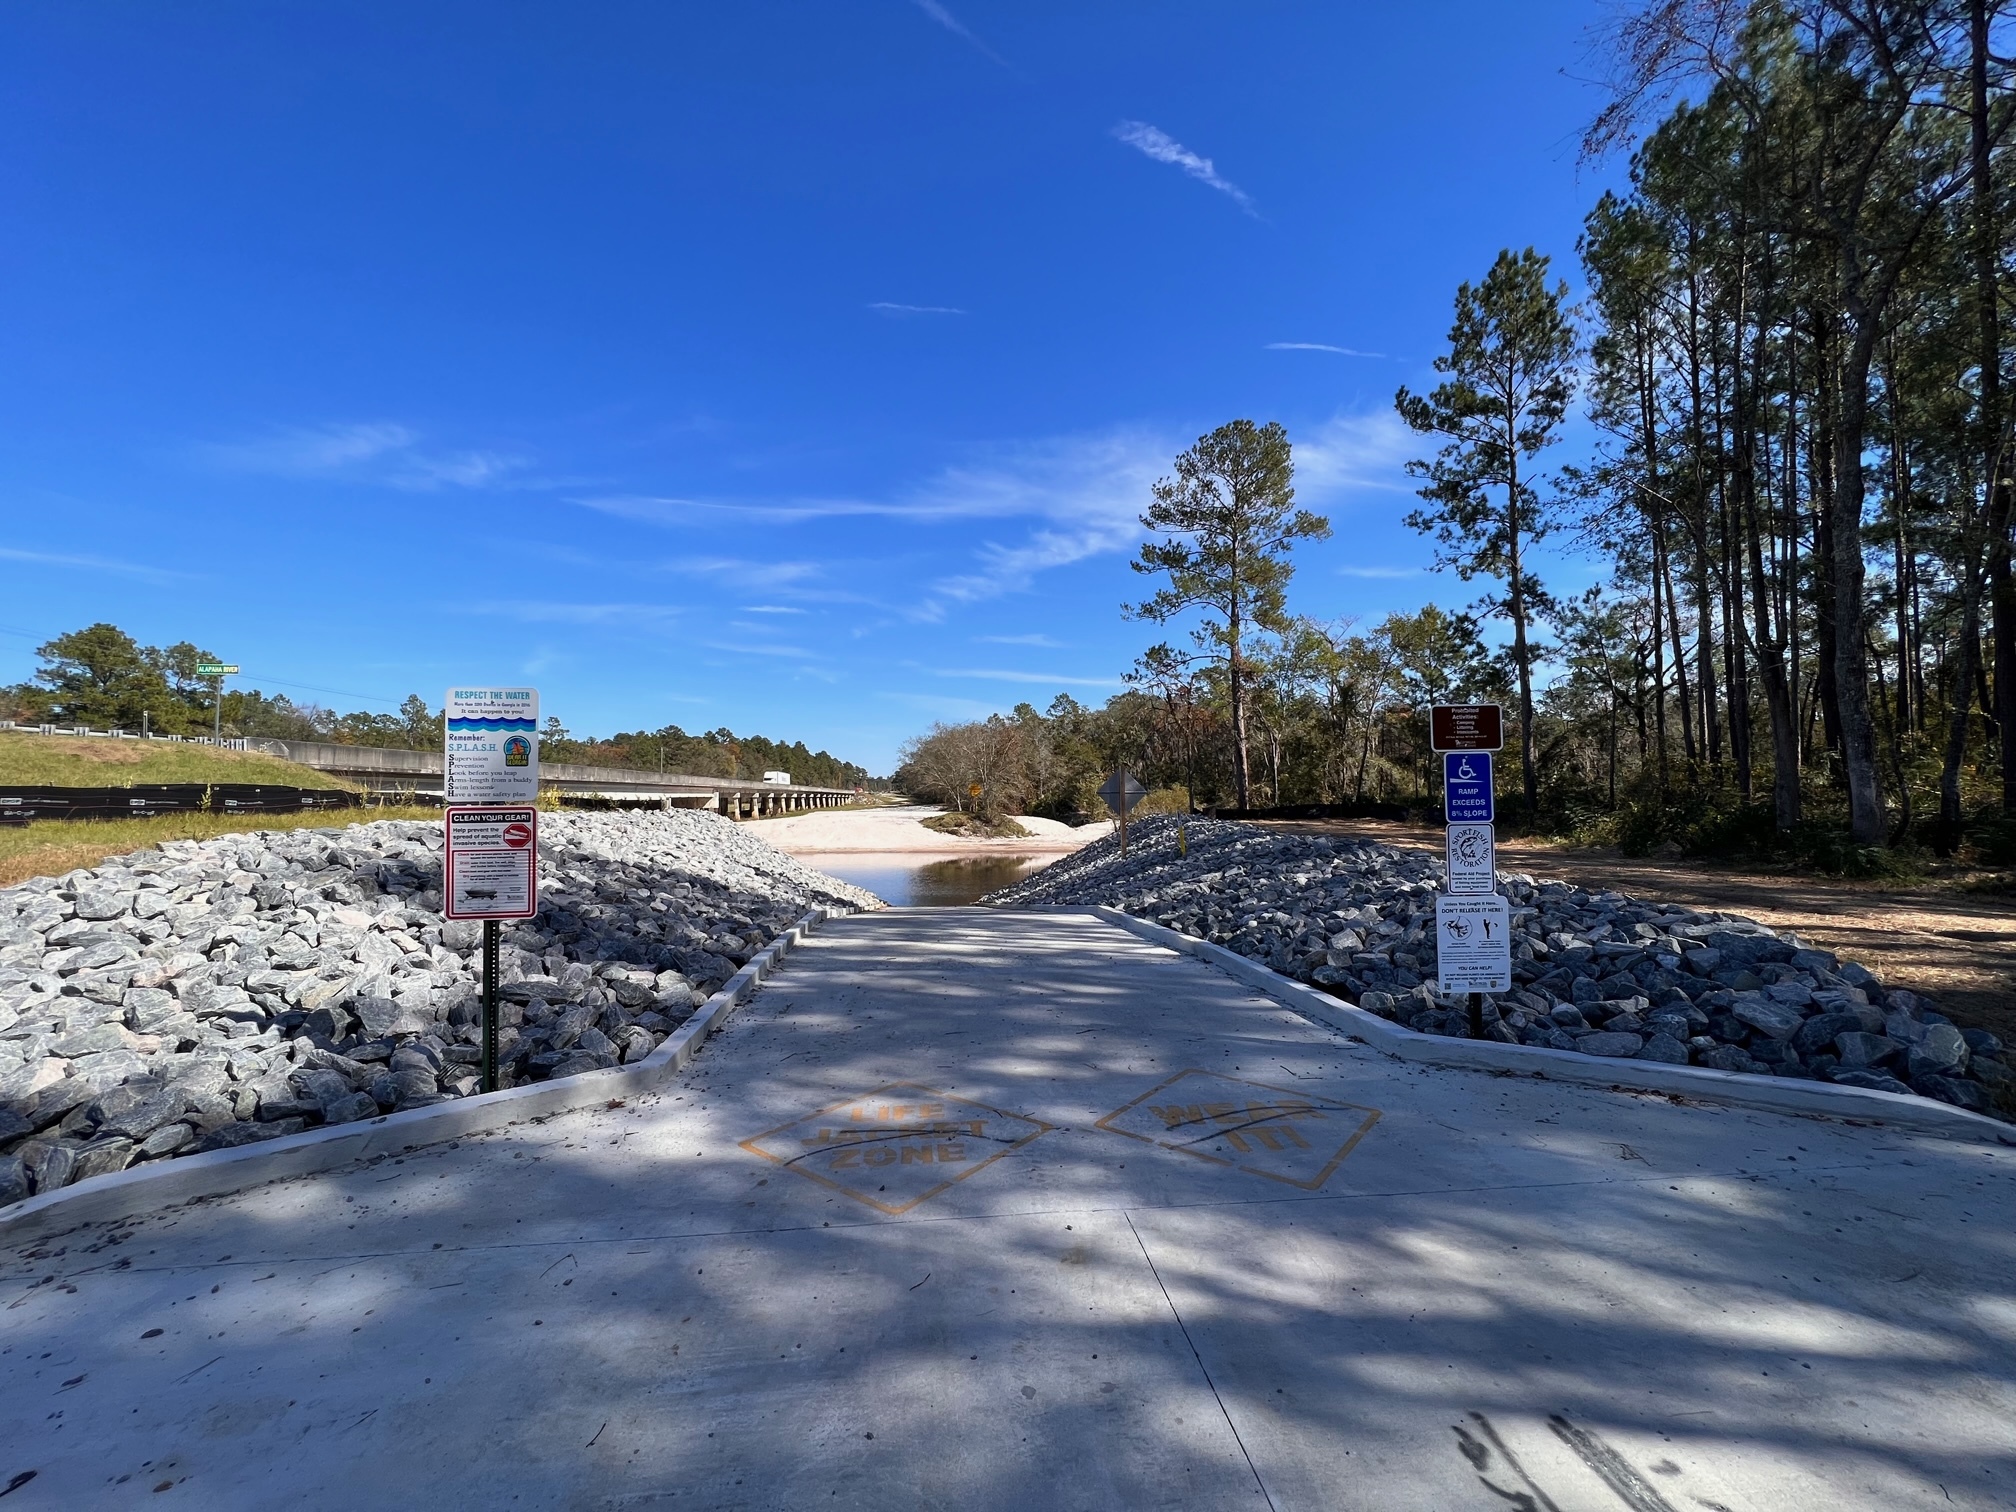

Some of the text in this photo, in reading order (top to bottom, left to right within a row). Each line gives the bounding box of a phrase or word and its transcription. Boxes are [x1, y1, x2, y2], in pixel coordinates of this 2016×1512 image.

[454, 691, 530, 700] RESPECT THE WATER
[448, 754, 488, 762] Supervision
[1452, 829, 1489, 845] SPORT FISH
[1451, 848, 1490, 868] RESTORATION
[849, 1102, 947, 1123] LIFE
[1148, 1100, 1328, 1129] WEAR
[800, 1119, 989, 1148] JACKET
[828, 1143, 968, 1170] ZONE
